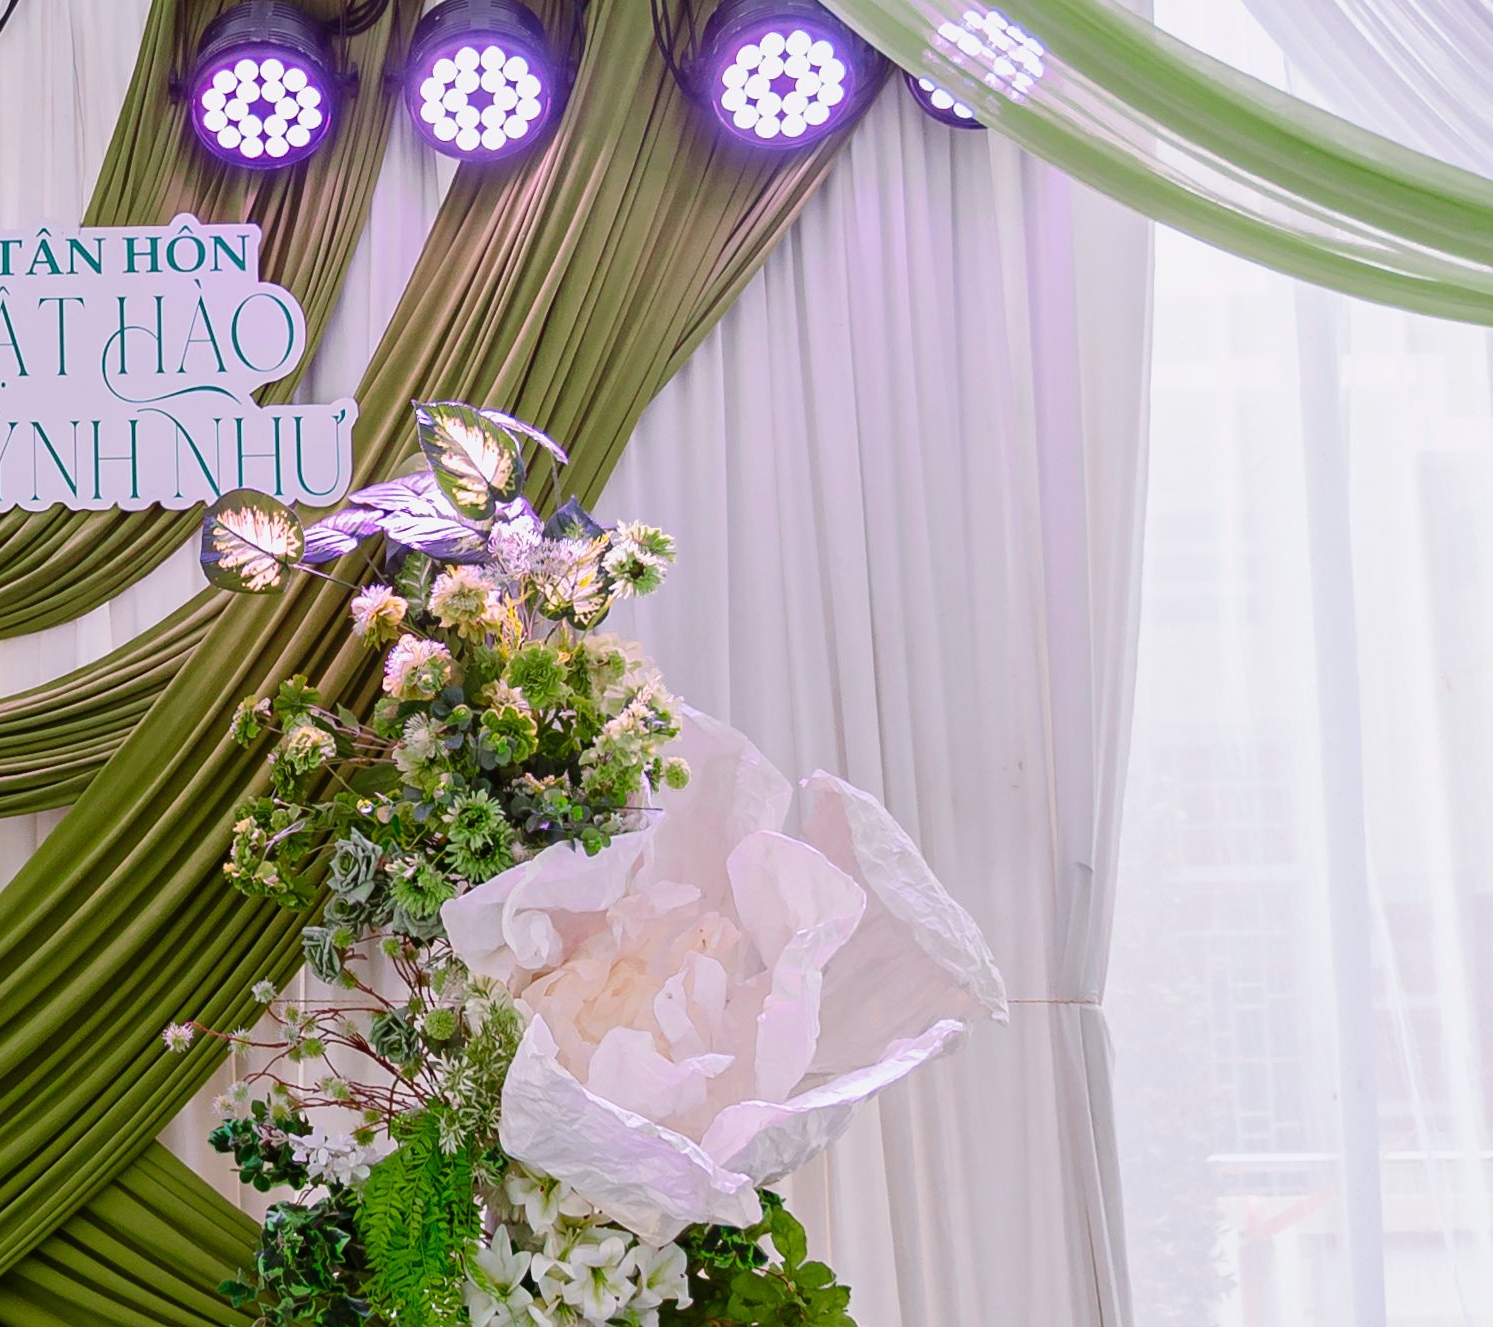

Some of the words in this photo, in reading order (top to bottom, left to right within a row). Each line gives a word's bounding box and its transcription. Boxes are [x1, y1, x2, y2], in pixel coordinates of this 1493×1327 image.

[123, 225, 249, 274] HÔN
[101, 278, 295, 405] HÀO
[137, 407, 347, 500] NHƯ
